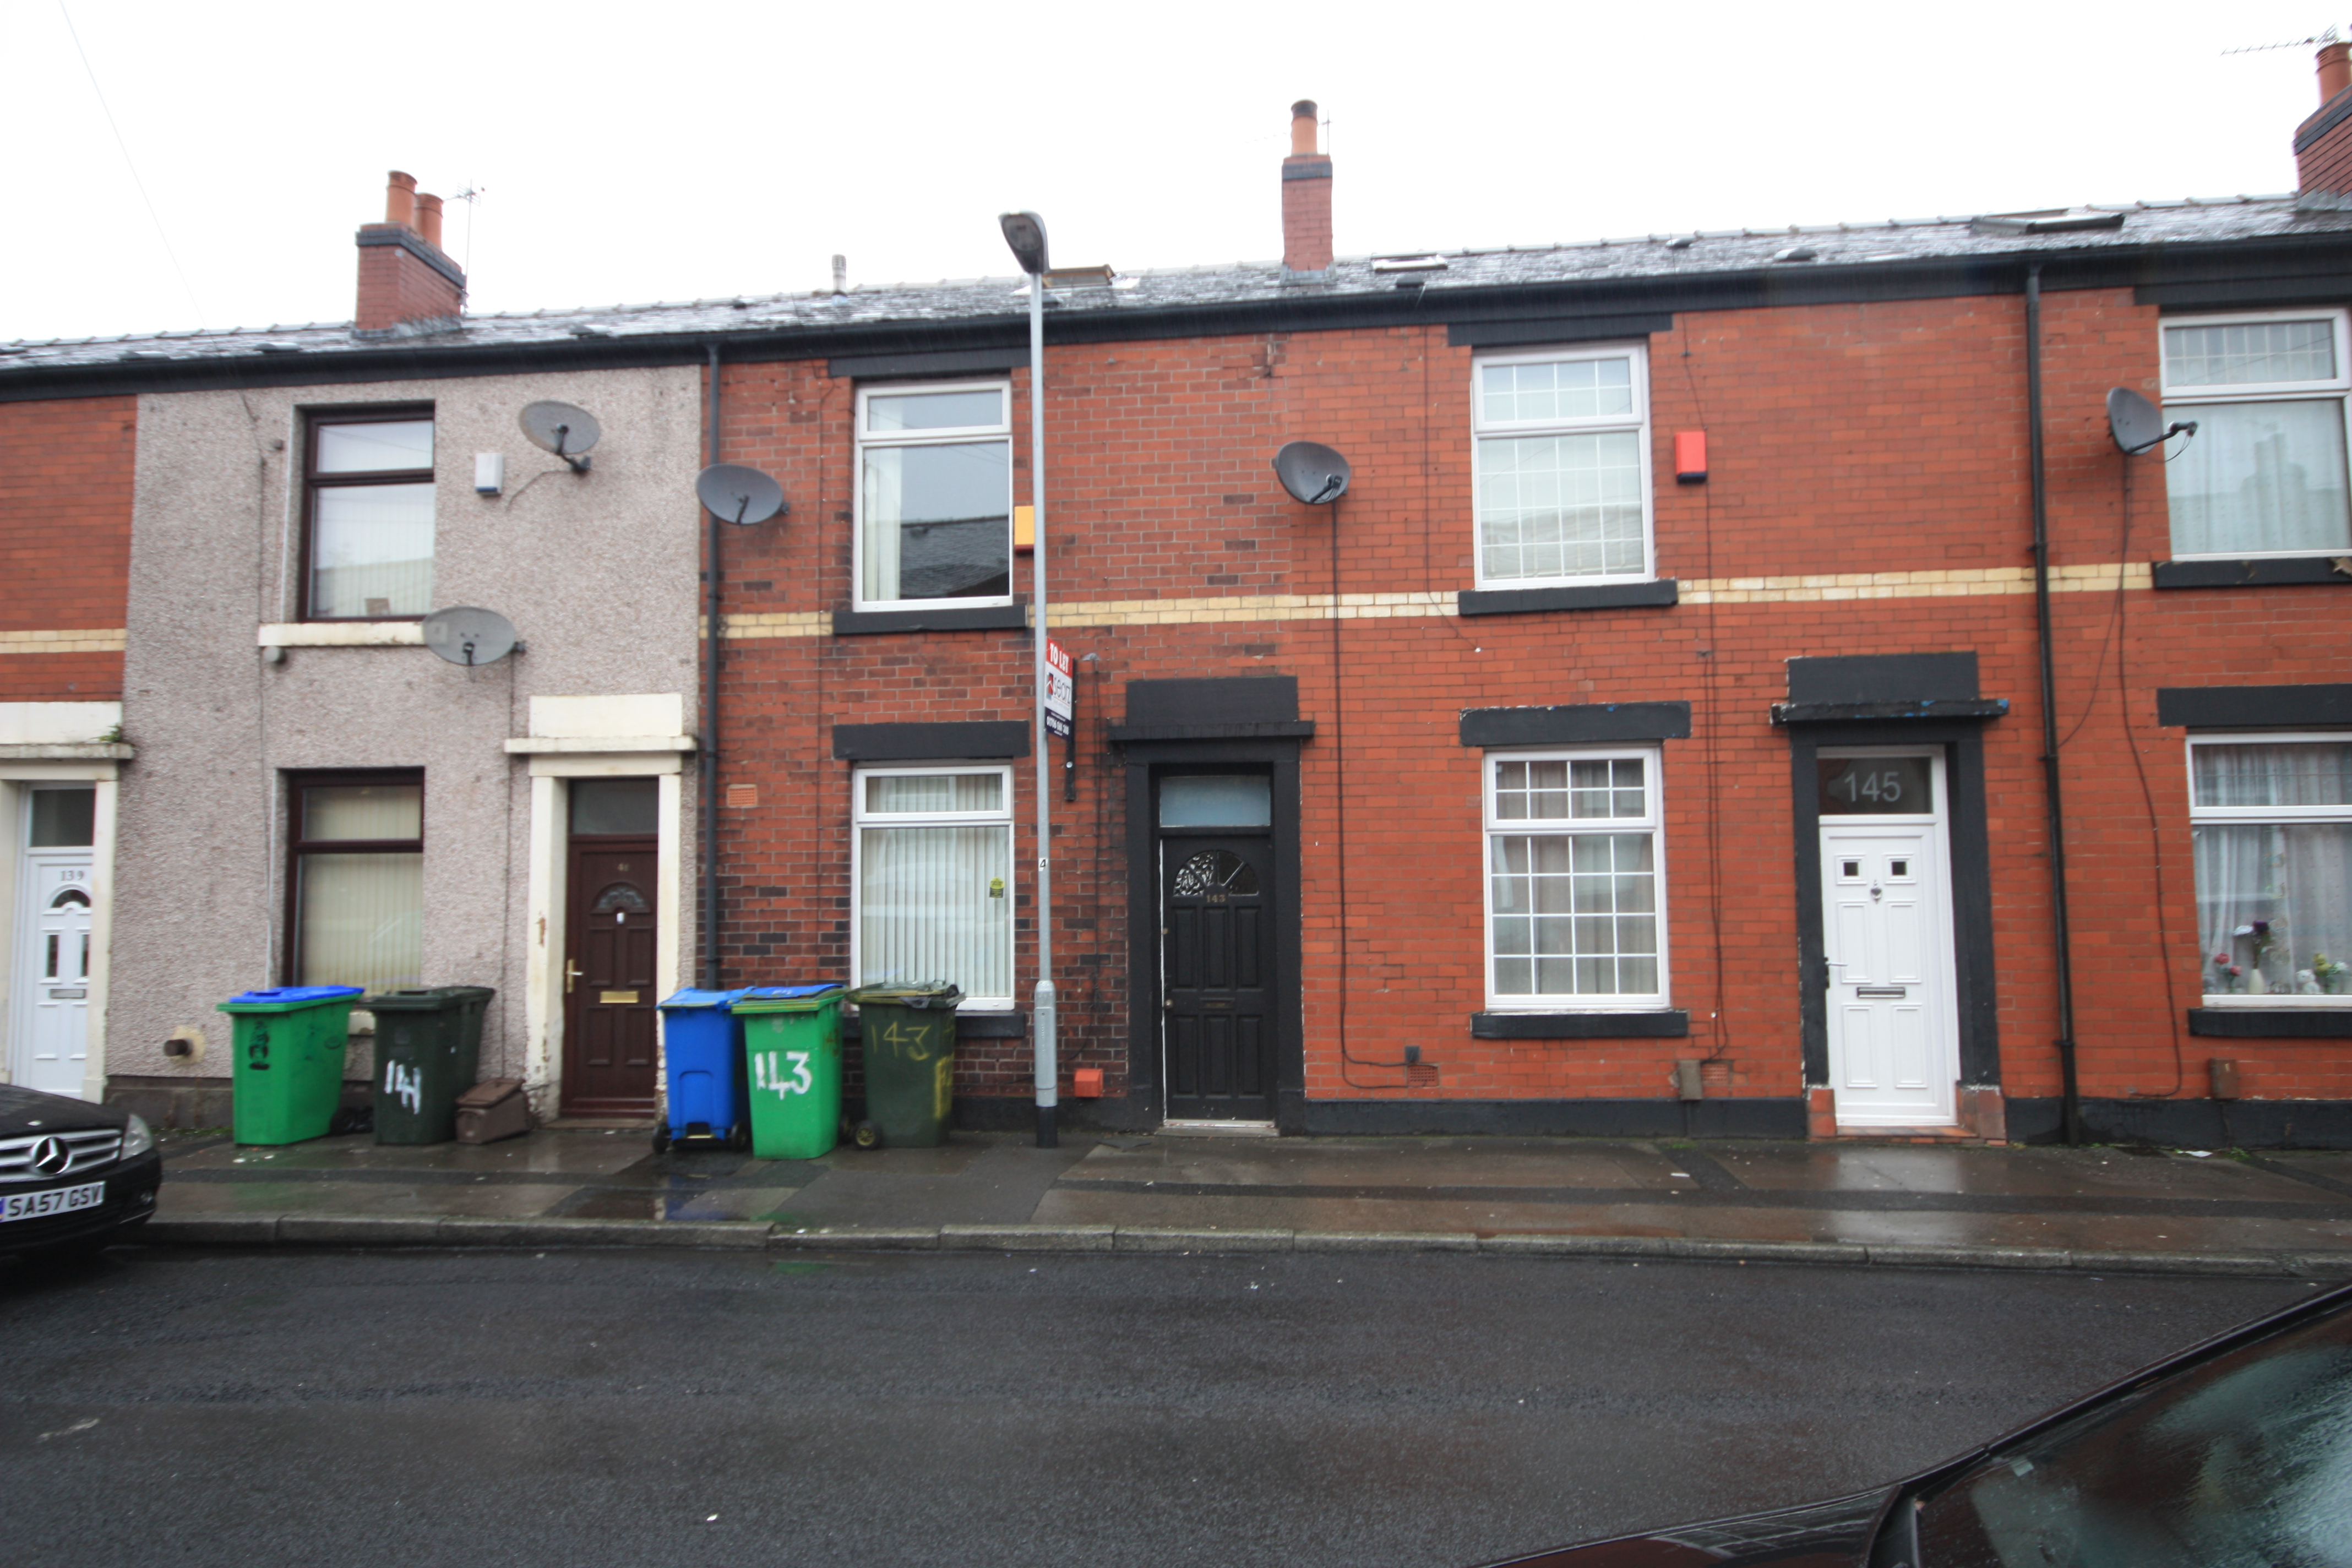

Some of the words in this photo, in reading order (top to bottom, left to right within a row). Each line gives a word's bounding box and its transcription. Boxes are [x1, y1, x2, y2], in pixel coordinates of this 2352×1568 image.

[1050, 643, 1058, 665] TO
[1059, 650, 1069, 673] LET
[1844, 772, 1901, 802] 145
[60, 870, 84, 881] 139
[1206, 894, 1226, 903] 143
[871, 1021, 931, 1061] 143
[754, 1051, 812, 1100] 143
[8, 1191, 66, 1218] SA57
[68, 1184, 102, 1207] GSV
